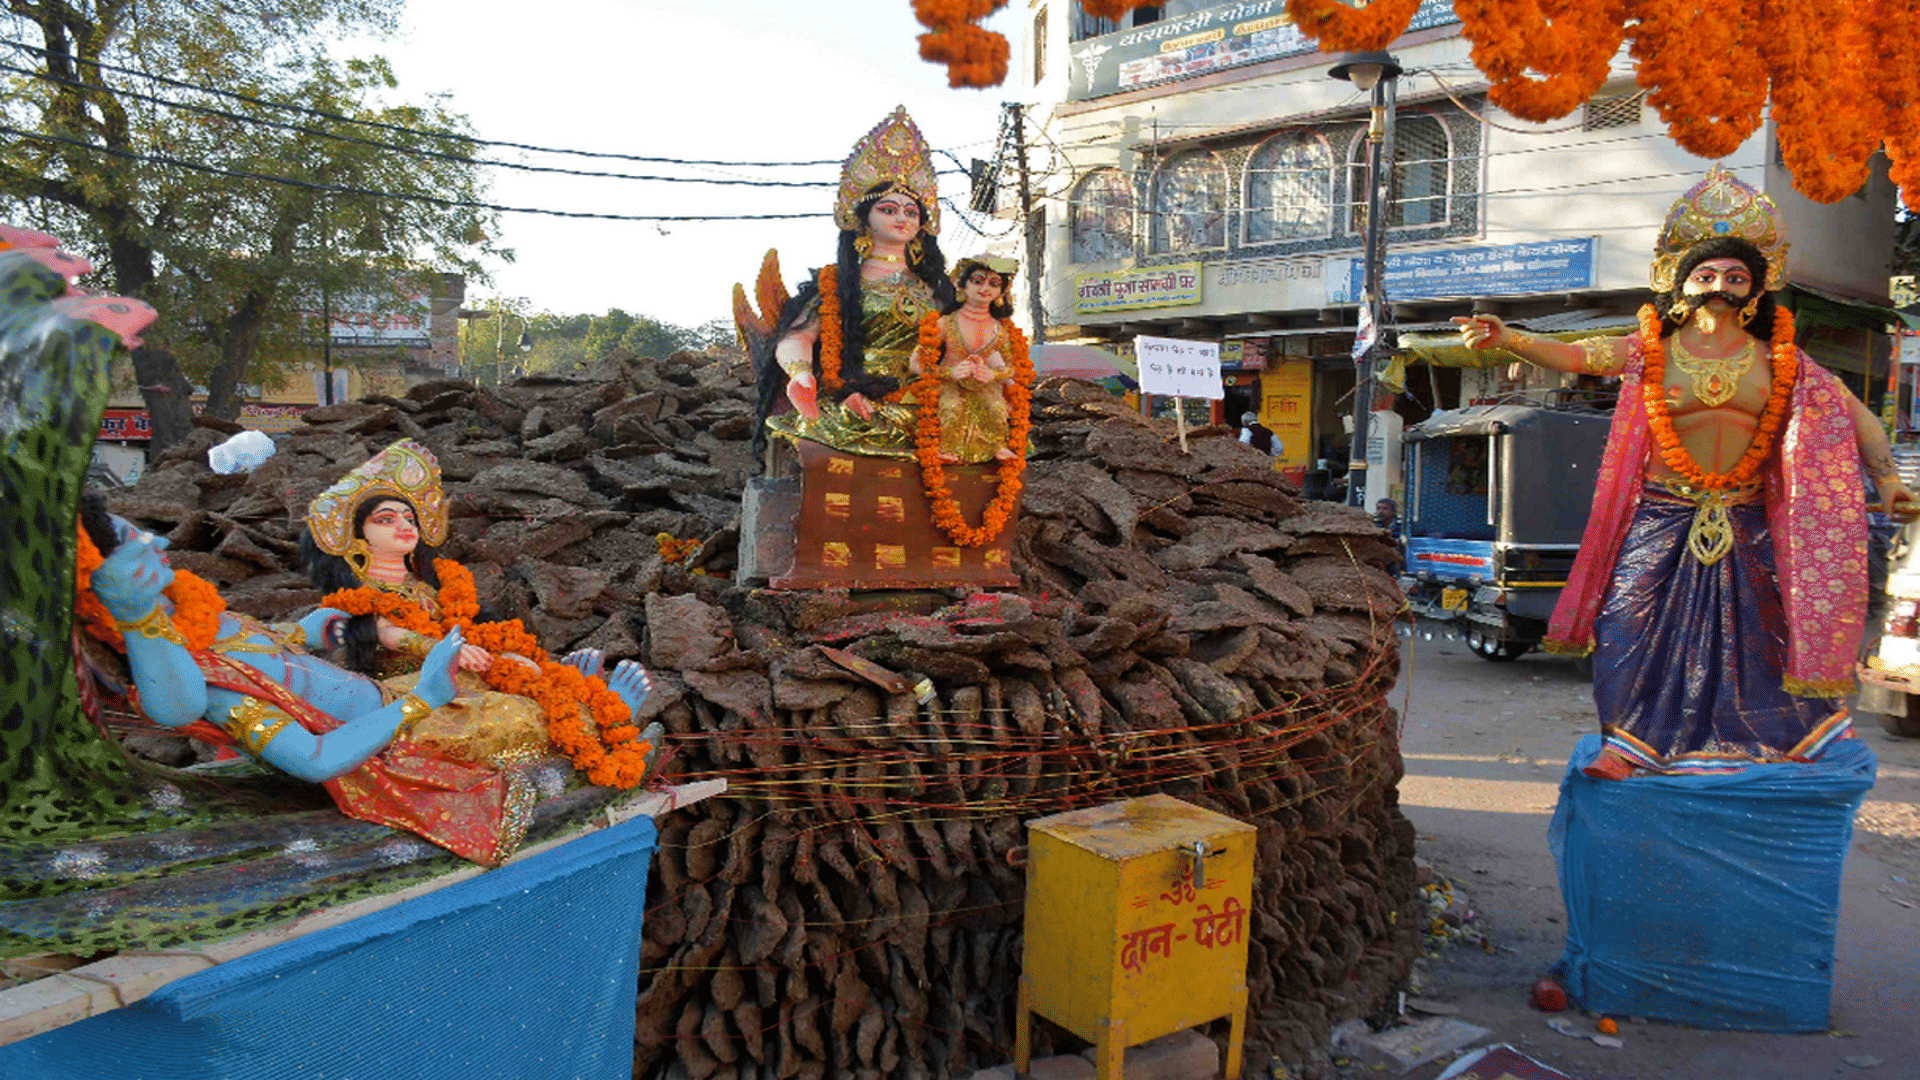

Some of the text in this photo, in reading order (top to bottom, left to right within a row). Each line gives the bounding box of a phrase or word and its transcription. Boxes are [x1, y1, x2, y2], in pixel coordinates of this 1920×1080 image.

[1120, 11, 1212, 46] वाराणसी
[1114, 281, 1136, 299] पूजा
[1180, 276, 1195, 288] घर
